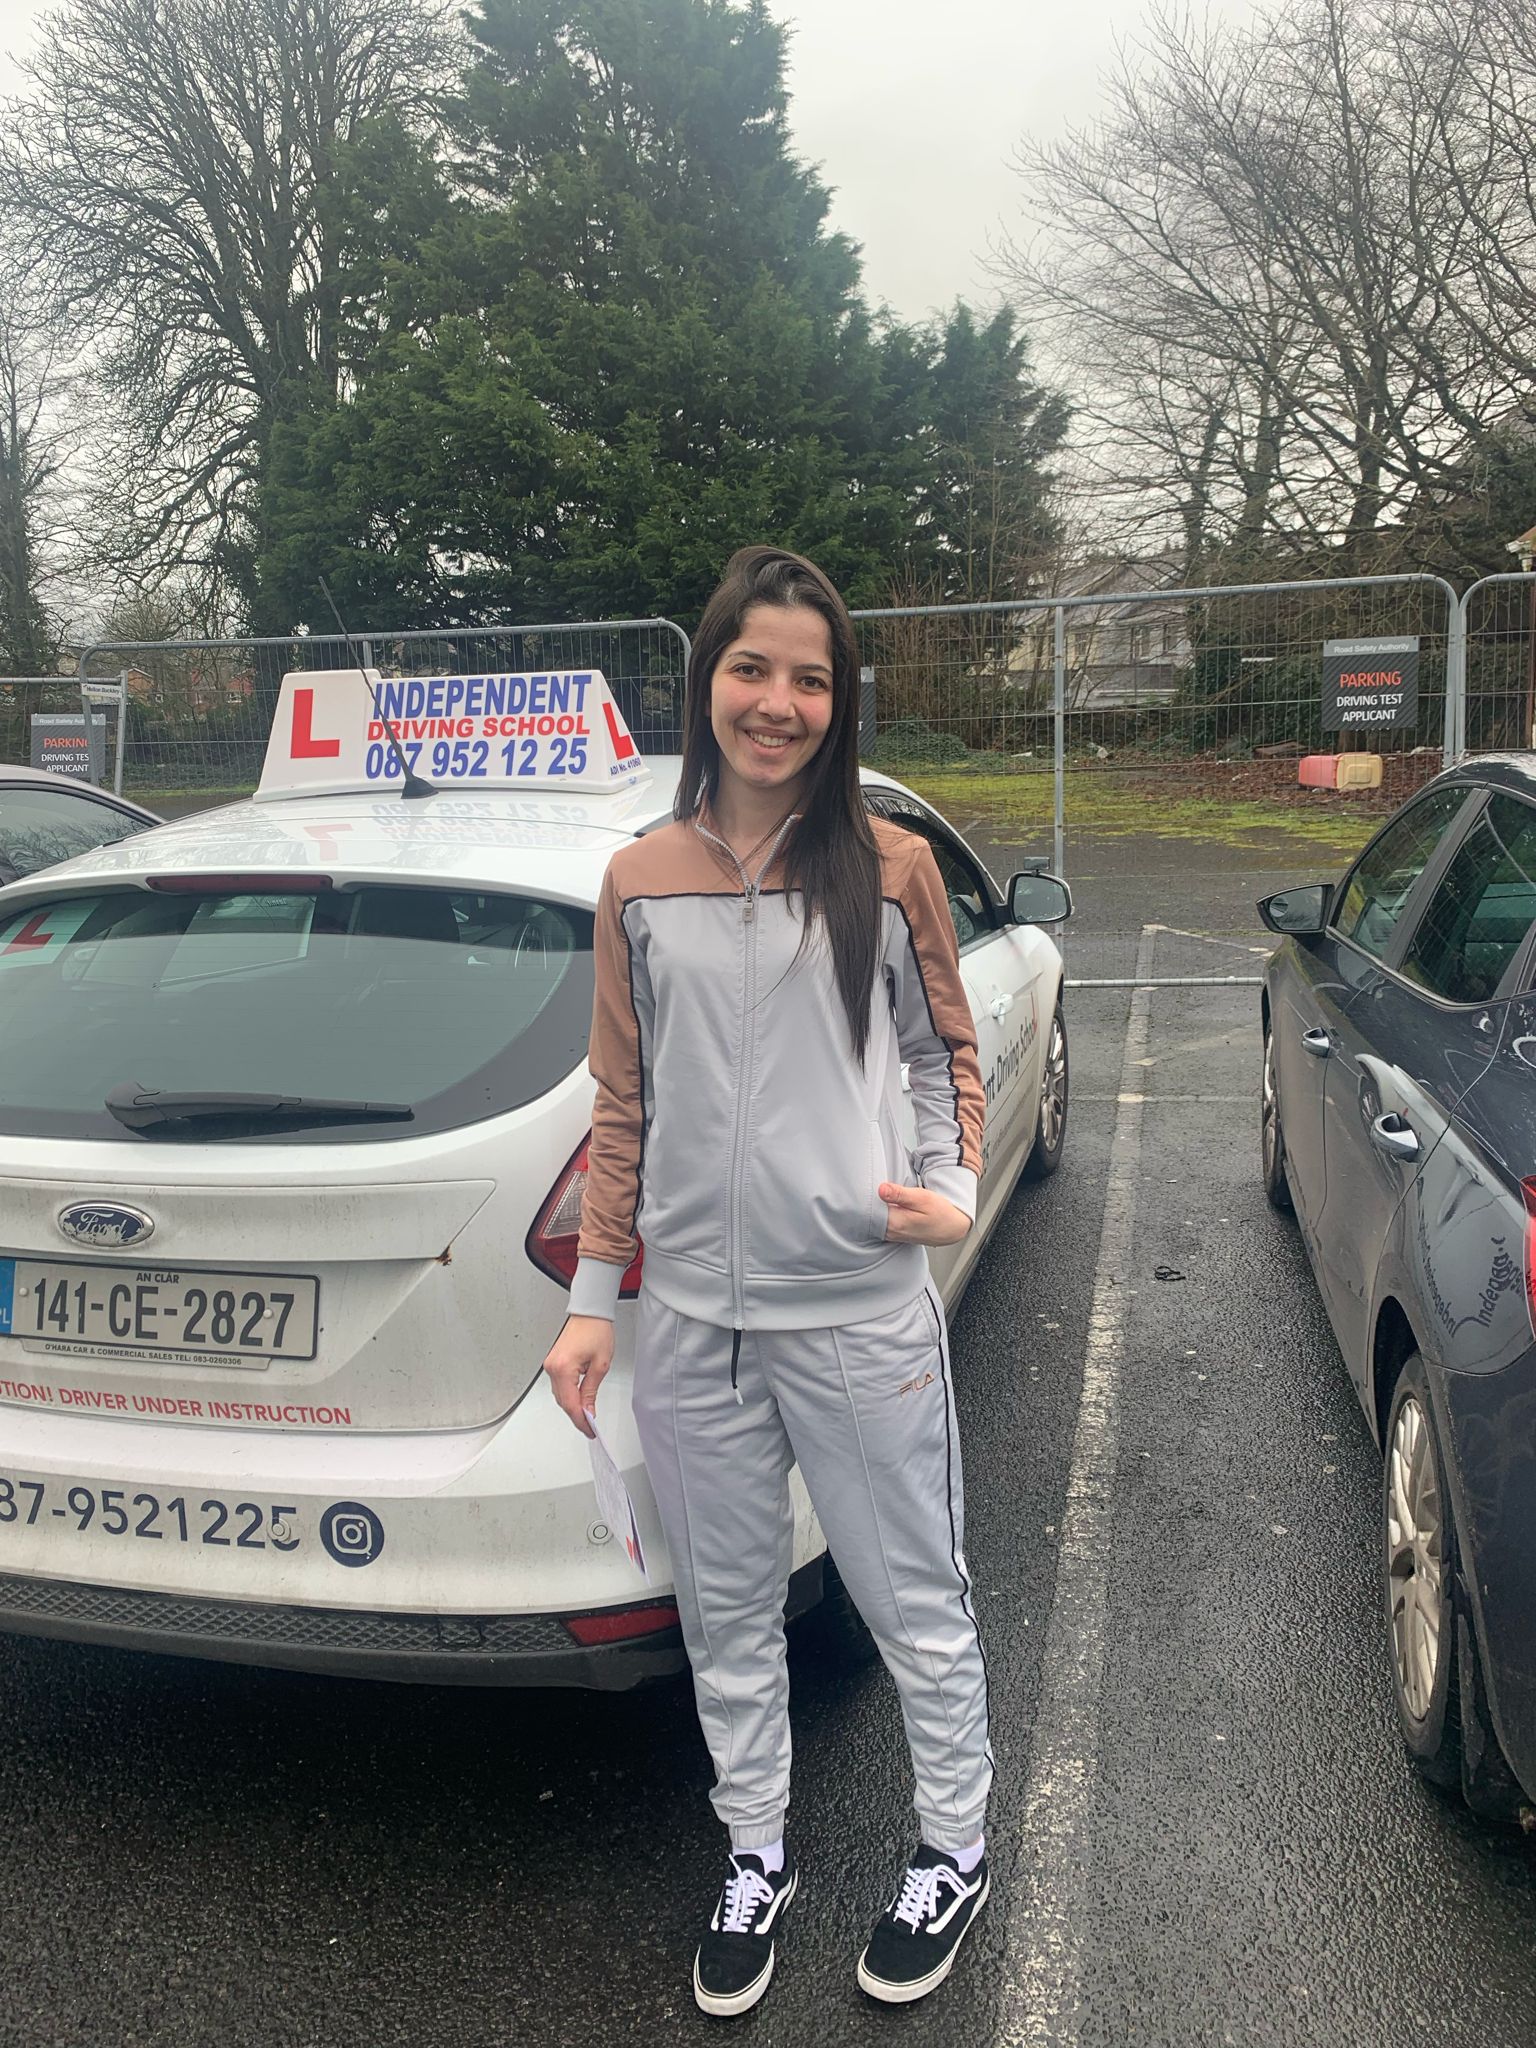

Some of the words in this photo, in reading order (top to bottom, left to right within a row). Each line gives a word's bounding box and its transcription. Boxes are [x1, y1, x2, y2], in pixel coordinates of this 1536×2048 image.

[1355, 644, 1377, 653] Safety
[1378, 642, 1409, 652] Authority
[1340, 670, 1403, 688] PARKING
[373, 674, 593, 719] INDEPENDENT
[1336, 694, 1378, 707] DRIVING
[1379, 693, 1404, 705] TEST
[291, 688, 340, 759] L
[367, 718, 474, 741] DRIVING
[482, 714, 591, 738] SCHOOL
[1342, 709, 1398, 722] APPLICANT
[602, 702, 635, 760] L
[41, 754, 74, 762] DRIVING
[76, 753, 90, 761] TES
[46, 764, 89, 772] APPLICANT
[365, 742, 423, 779] 087
[431, 740, 490, 778] 952
[501, 738, 539, 777] 12
[547, 737, 588, 776] 25
[996, 1039, 1019, 1093] Driving
[76, 1211, 127, 1240] Ford
[136, 1272, 152, 1283] AN
[154, 1271, 180, 1284] CLÁR
[34, 1278, 295, 1348] 141-CE-2827
[45, 1343, 72, 1352] O'HARA
[73, 1346, 88, 1354] CAR
[90, 1347, 96, 1355] &
[97, 1348, 146, 1359] COMMERCIAL
[148, 1352, 173, 1361] SALES
[175, 1354, 191, 1362] TEL:
[58, 1388, 128, 1411] DRIVER
[132, 1396, 204, 1417] UNDER
[208, 1401, 352, 1425] INSTRUCTION
